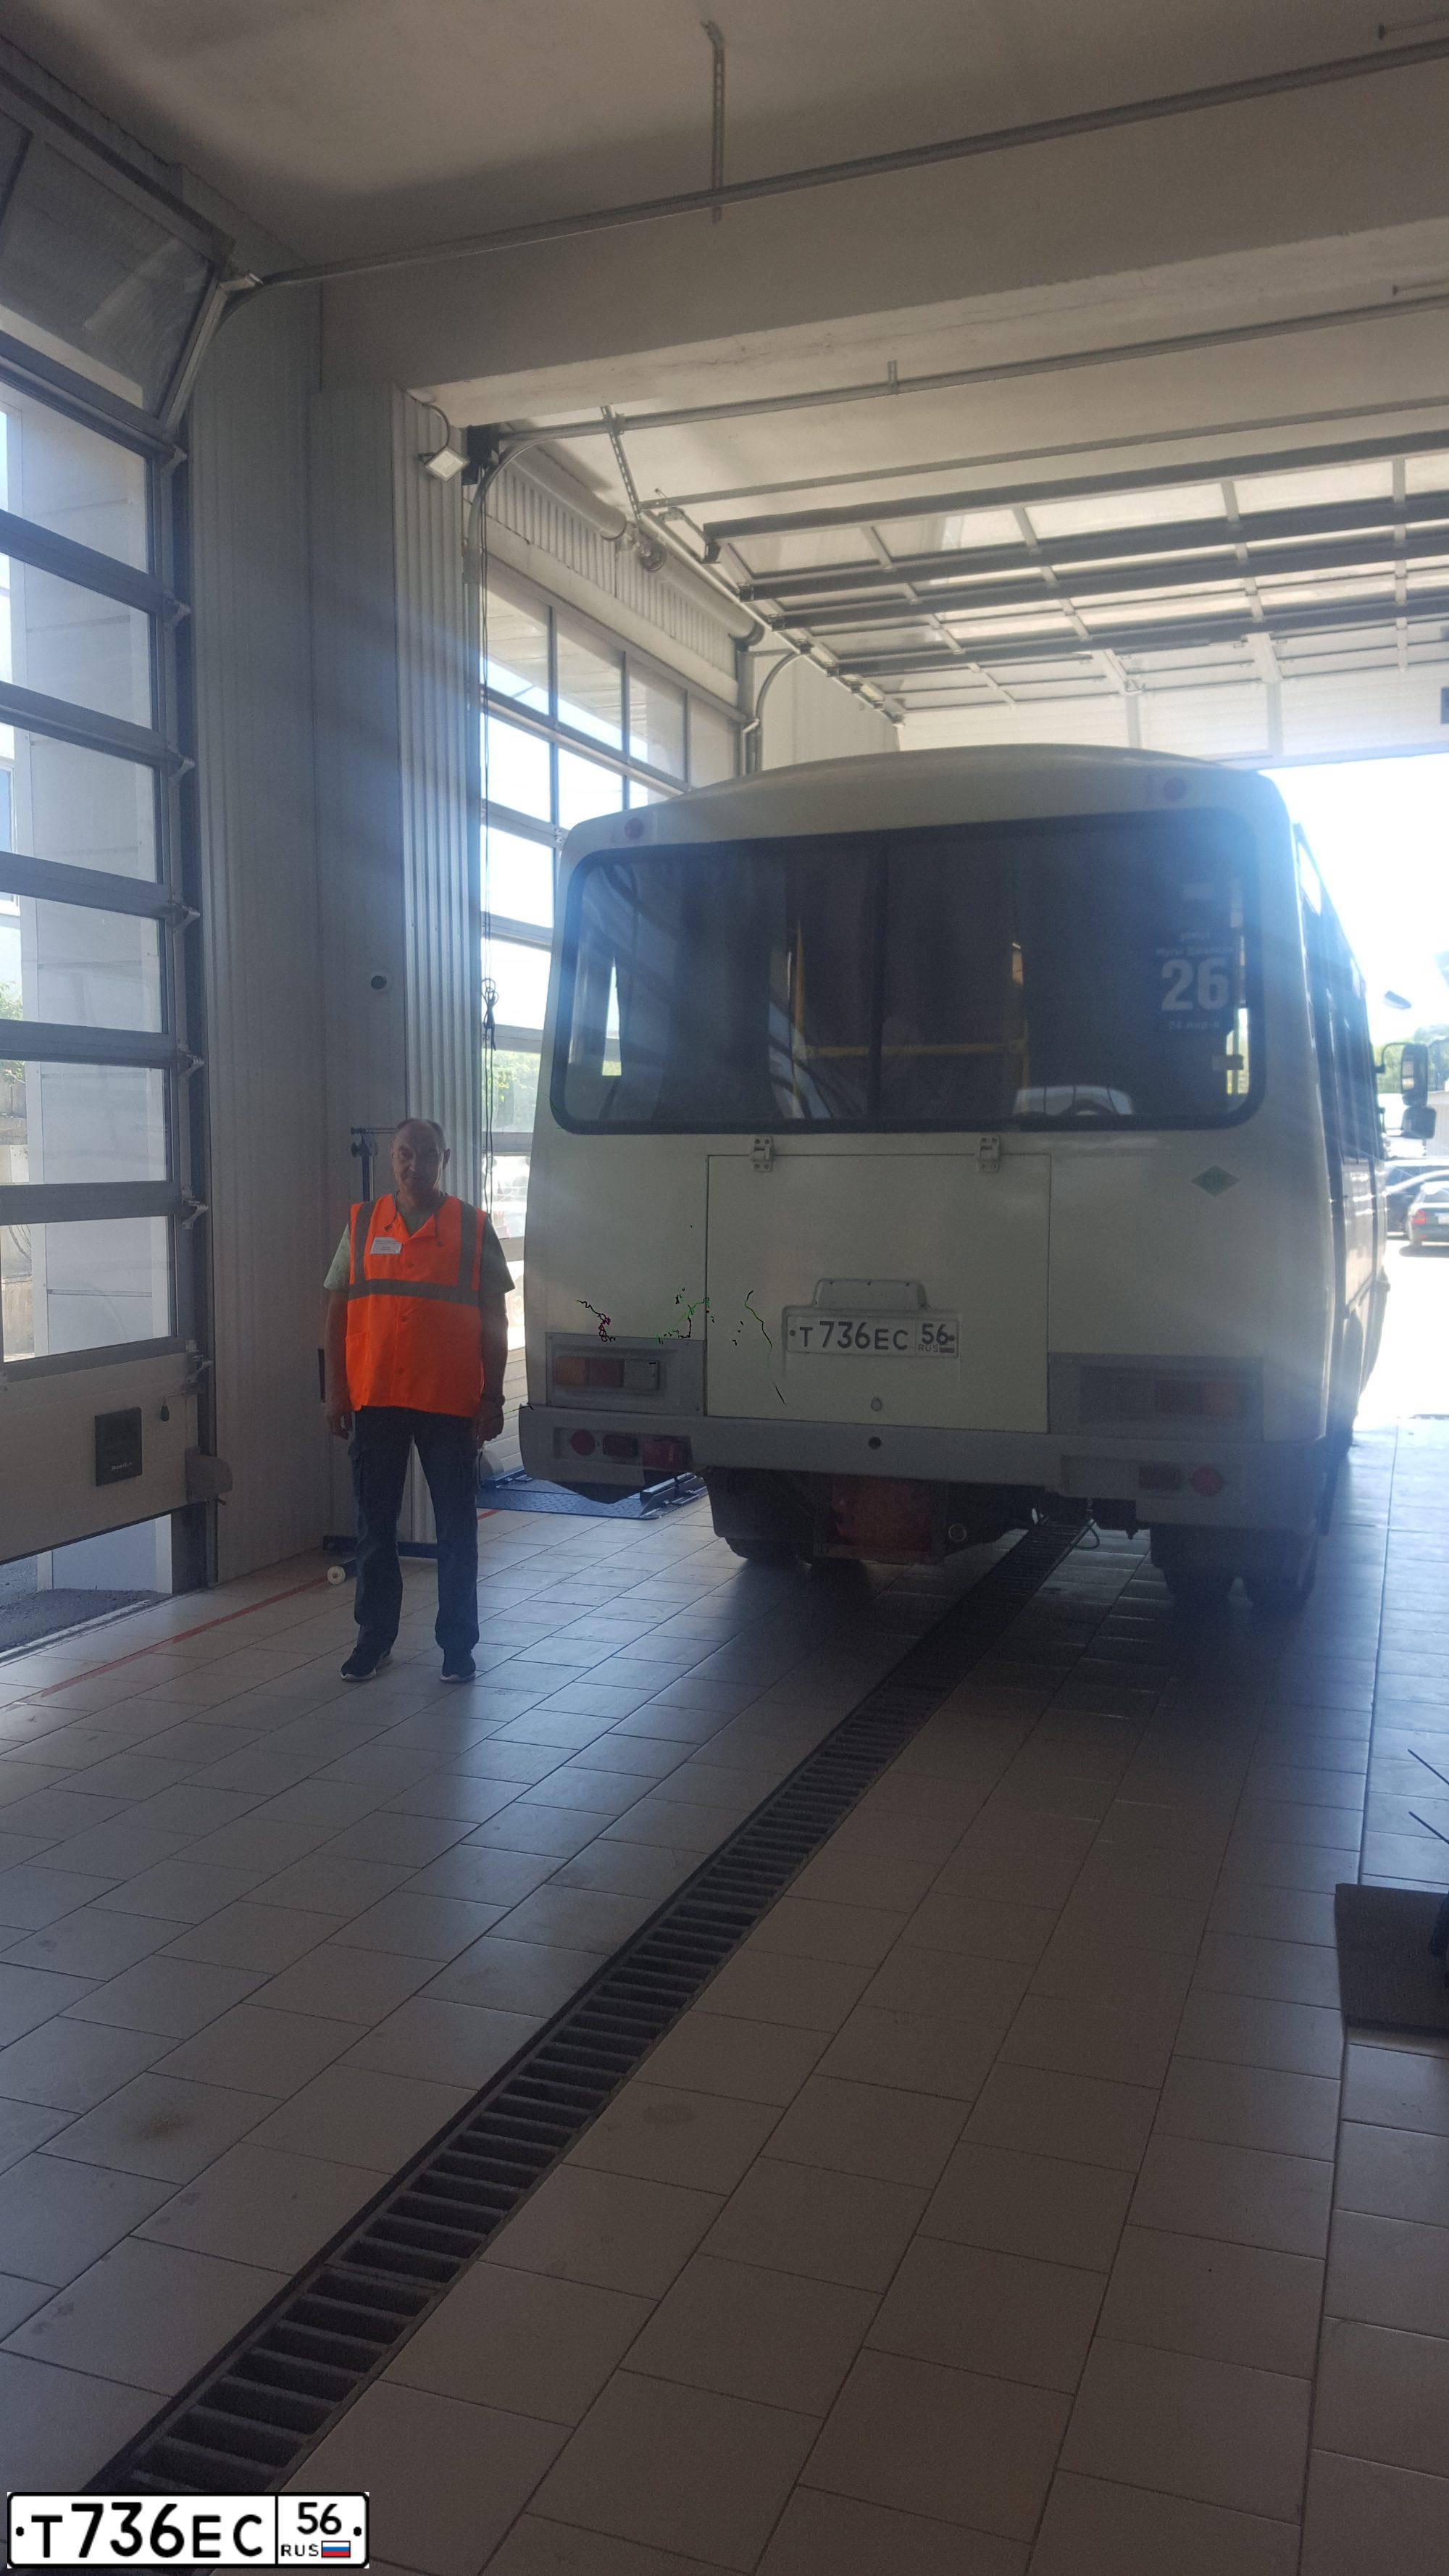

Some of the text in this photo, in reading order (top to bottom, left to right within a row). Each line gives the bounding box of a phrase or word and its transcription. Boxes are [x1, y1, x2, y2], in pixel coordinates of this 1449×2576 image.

[1161, 957, 1229, 1011] 26
[922, 1323, 948, 1345] 56
[918, 1343, 939, 1352] RUS
